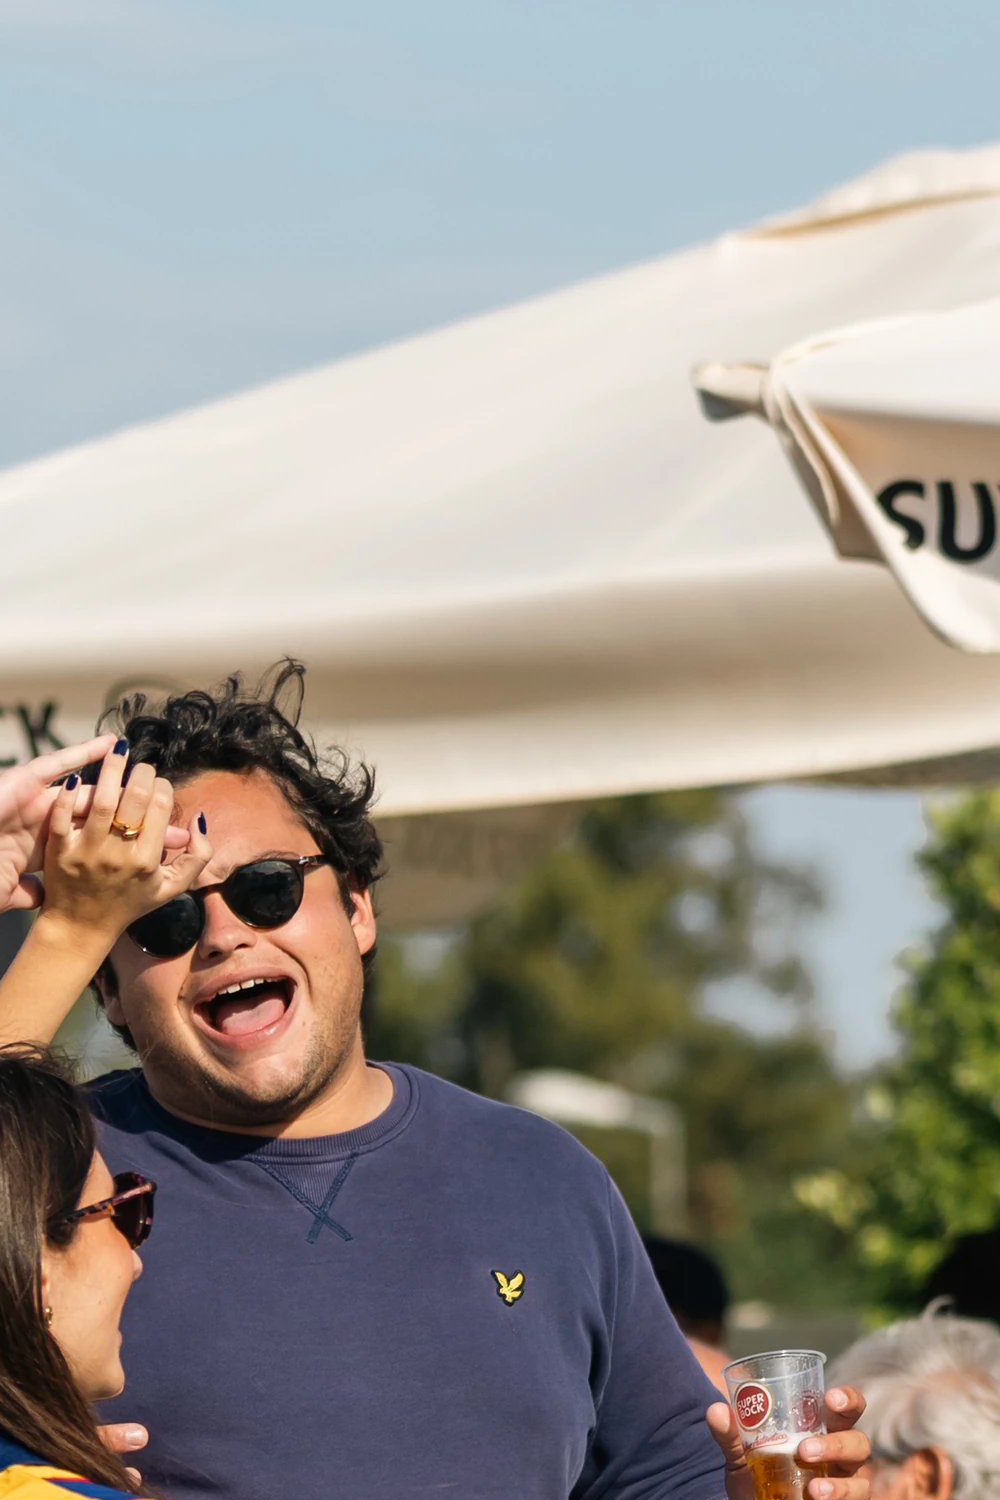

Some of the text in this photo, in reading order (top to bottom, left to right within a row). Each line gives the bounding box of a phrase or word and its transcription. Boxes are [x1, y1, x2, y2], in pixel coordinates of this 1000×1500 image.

[876, 479, 1000, 563] SU
[738, 1392, 765, 1411] SUPER
[740, 1403, 765, 1420] BOCK
